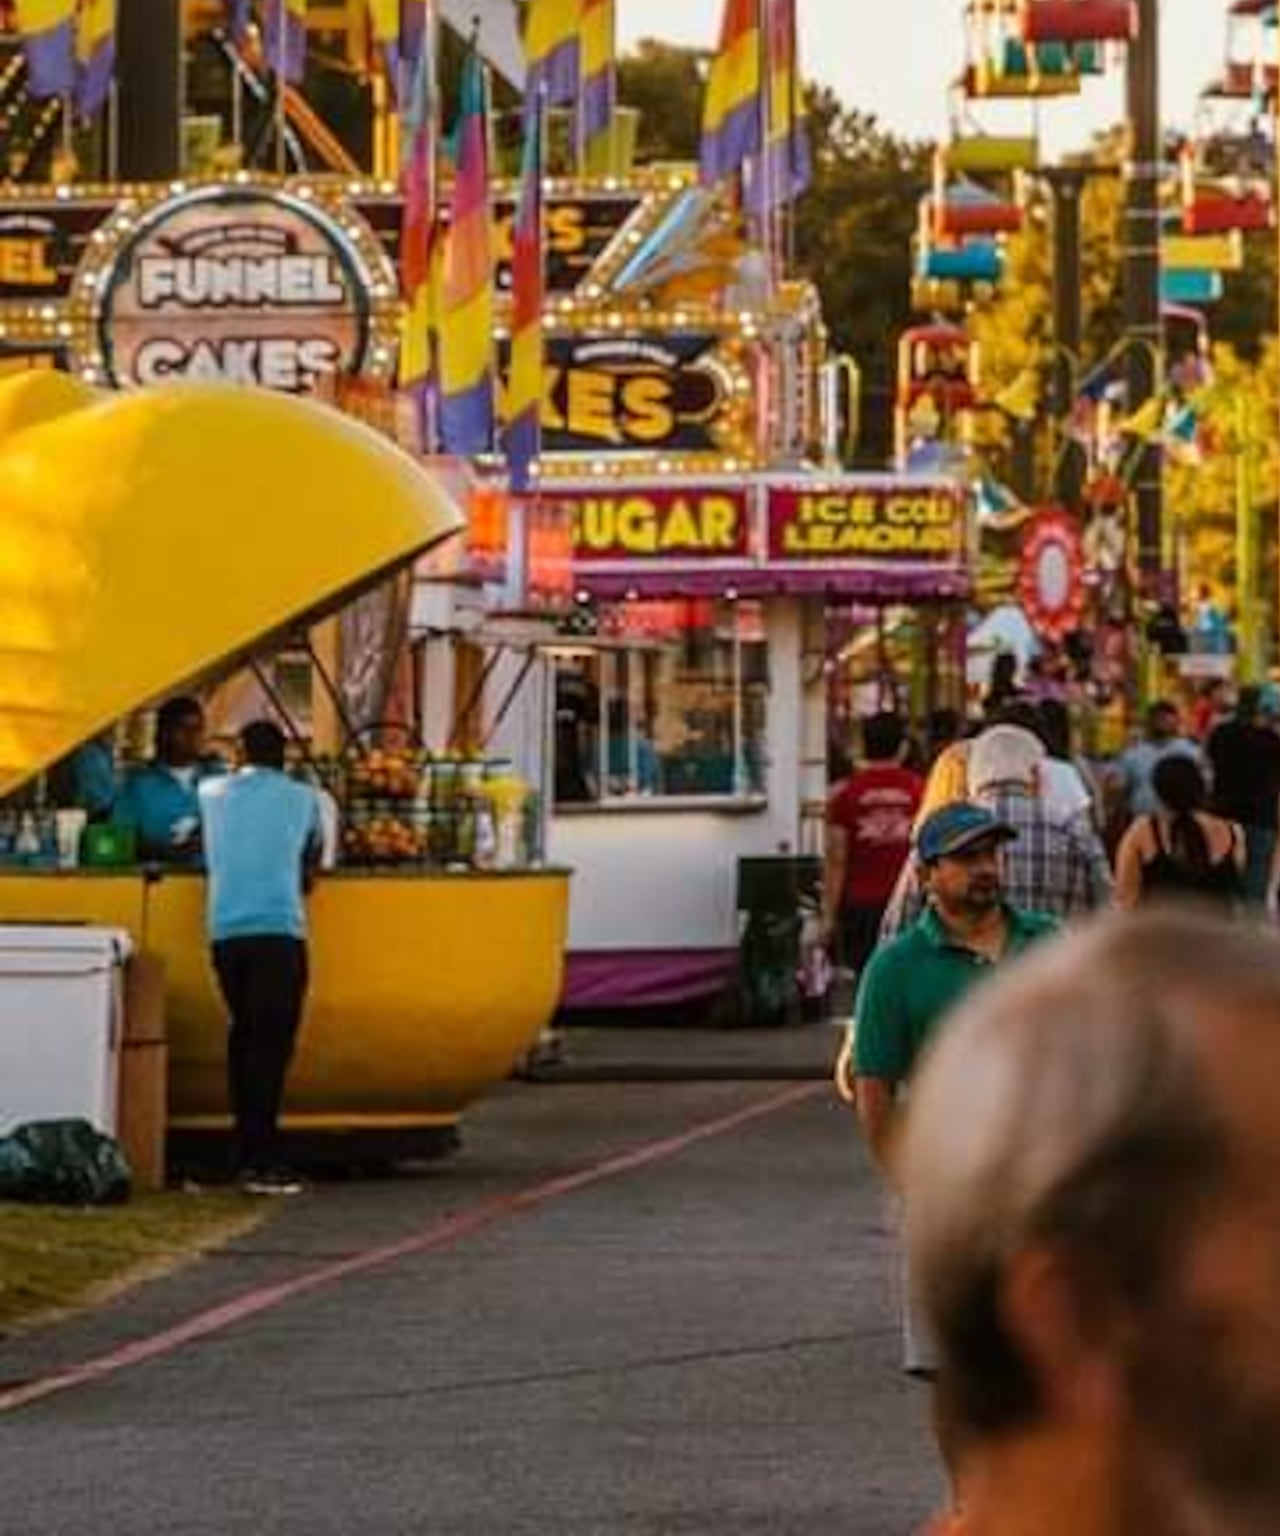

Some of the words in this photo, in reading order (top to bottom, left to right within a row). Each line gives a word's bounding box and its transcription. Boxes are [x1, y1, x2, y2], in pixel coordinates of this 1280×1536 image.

[138, 254, 344, 306] FUNNEL
[137, 338, 339, 390] CAKES
[571, 495, 738, 553] UGAR
[800, 496, 877, 525] ICE
